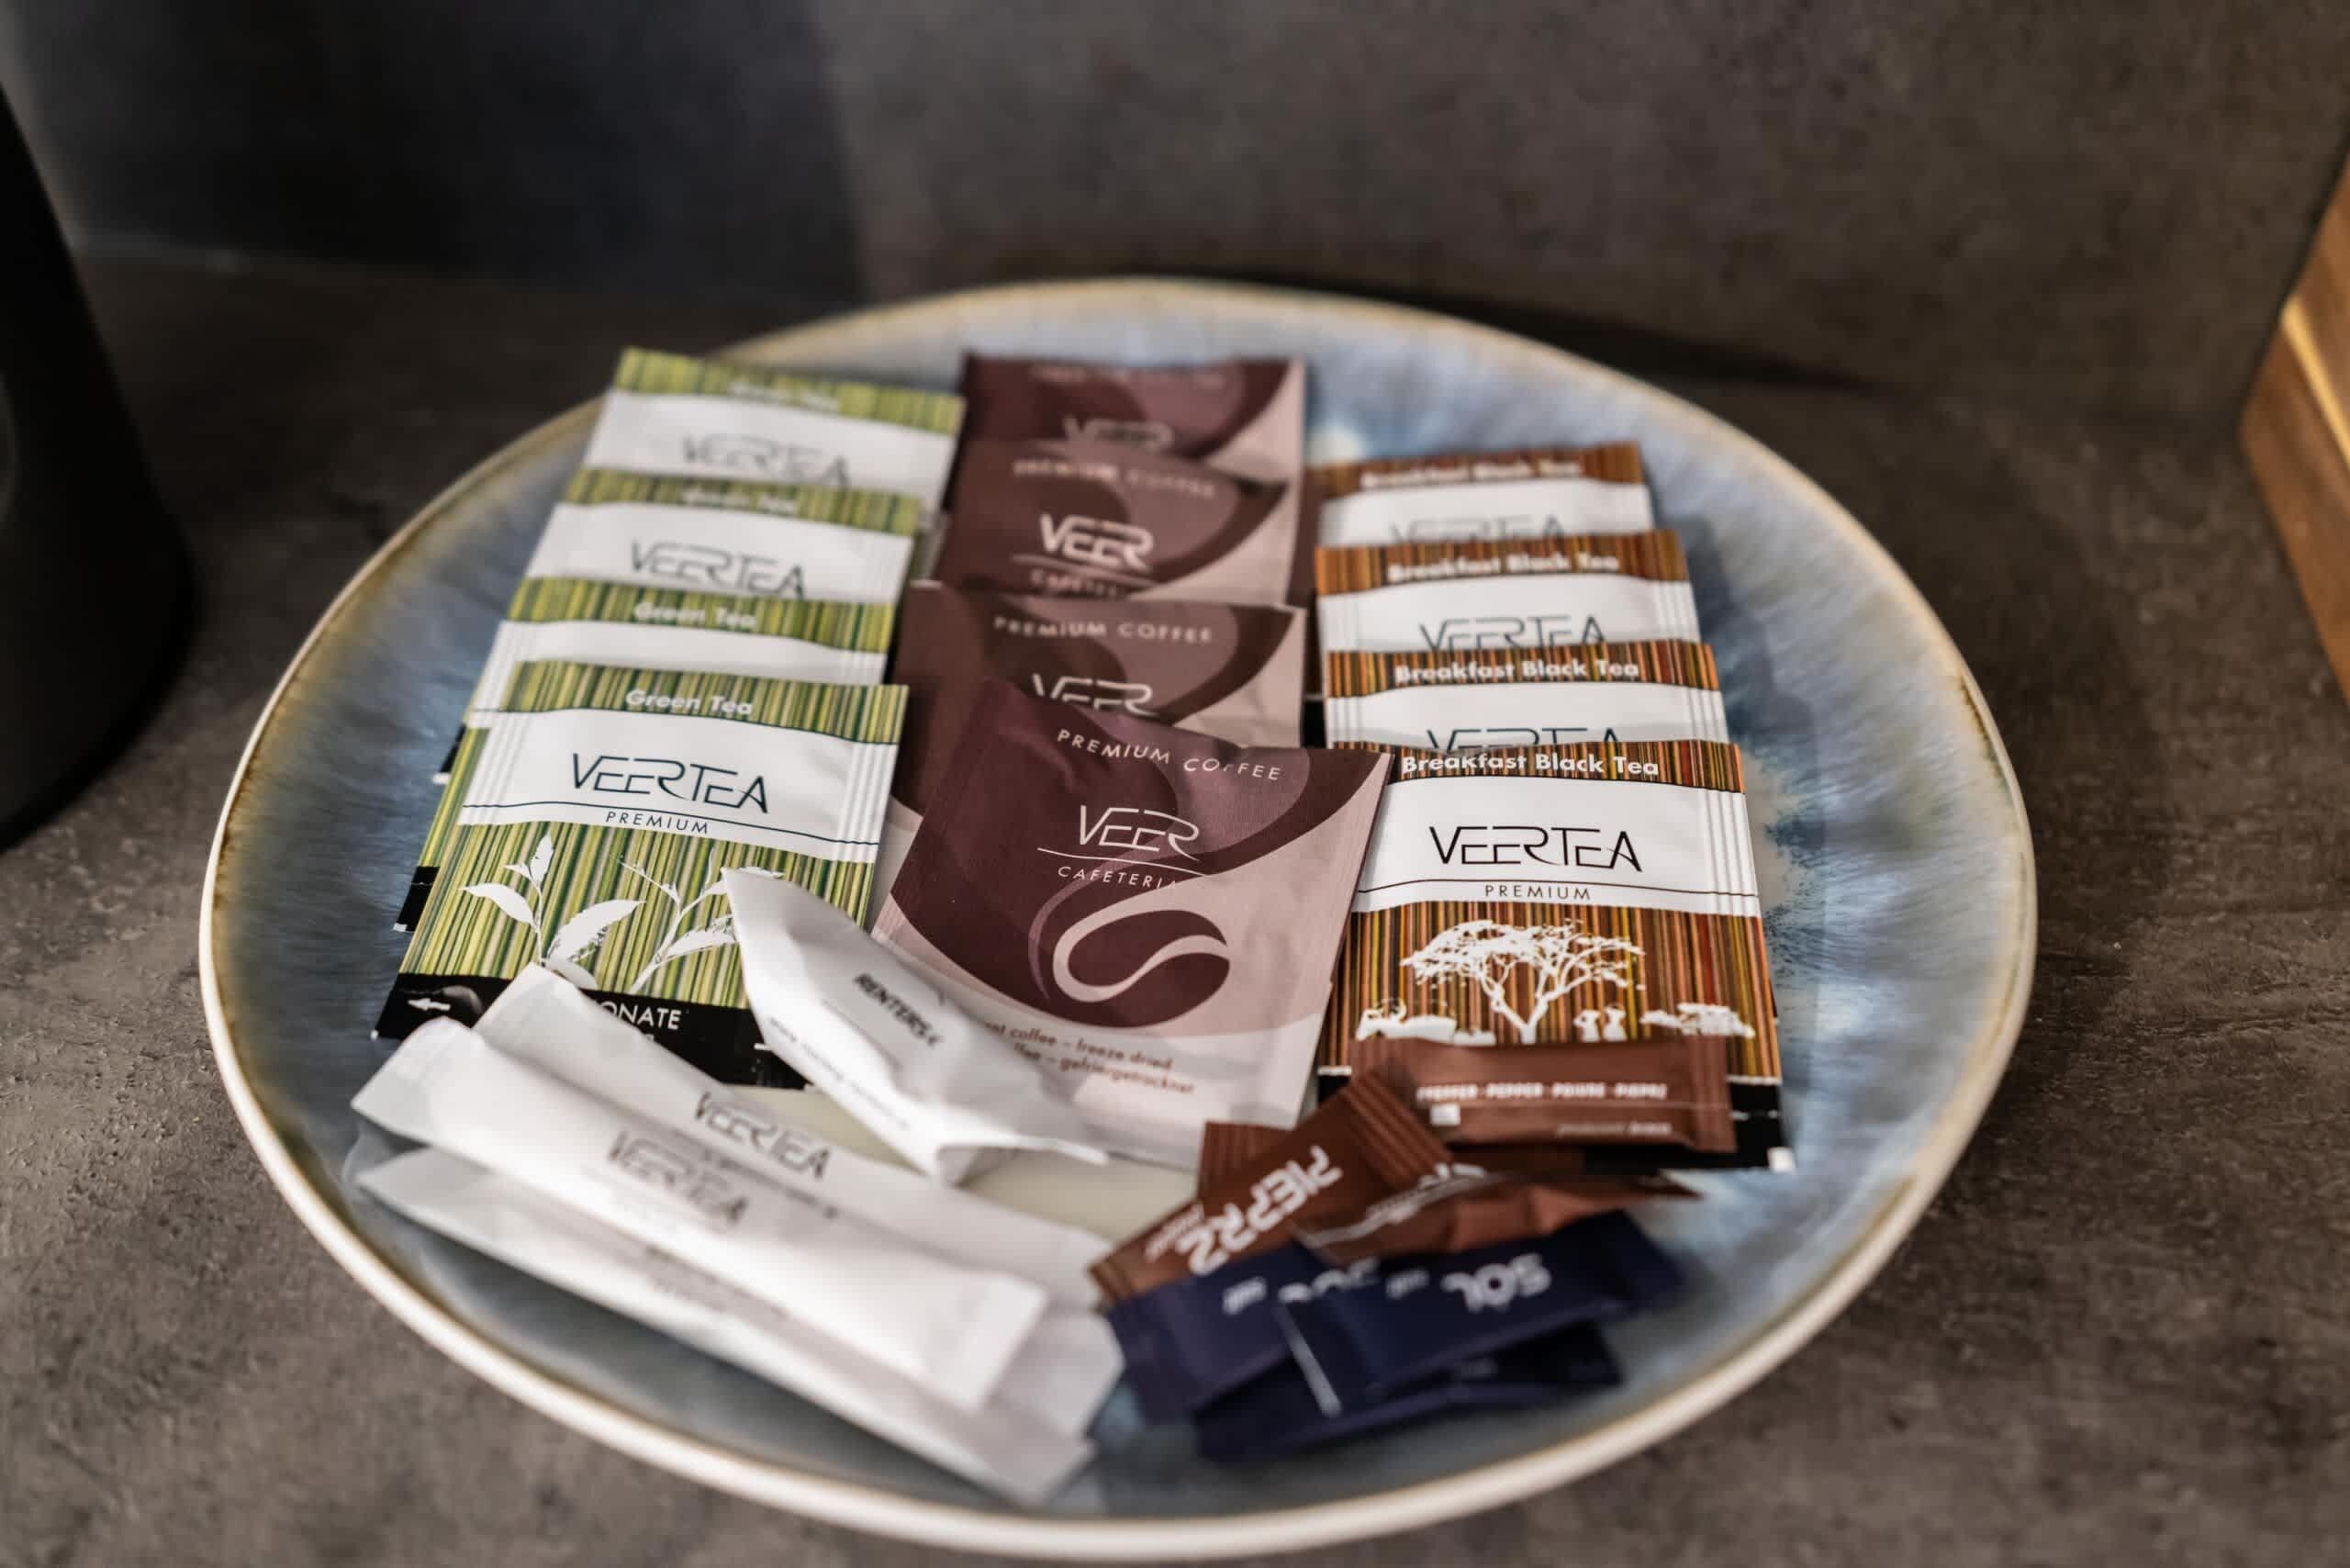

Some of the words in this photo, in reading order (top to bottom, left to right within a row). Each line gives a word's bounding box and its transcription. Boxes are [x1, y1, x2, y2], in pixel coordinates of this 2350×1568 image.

[1040, 512, 1153, 573] VEER
[631, 539, 805, 600] VEERTEA
[635, 601, 706, 624] Green
[716, 607, 756, 628] Tea
[994, 616, 1106, 637] PREMIUM
[1118, 622, 1211, 643] COFFEE
[1394, 662, 1515, 683] Breakfast
[1521, 658, 1587, 678] Black
[1596, 659, 1639, 678] Tea
[625, 689, 700, 710] Green
[711, 696, 753, 715] Tea
[1058, 729, 1170, 765] PREMIUM
[1402, 755, 1528, 775] Breakfast
[1535, 752, 1605, 773] Black
[1613, 756, 1659, 776] Tea
[572, 753, 768, 814] VEERTEA
[606, 811, 709, 834] PREMIUM
[1079, 804, 1202, 862] VEER
[1429, 826, 1643, 872] VEERTEA
[1058, 866, 1178, 890] CAFETERIA
[1484, 884, 1591, 901] PREMIUM
[1011, 1027, 1057, 1047] coffee
[1076, 1038, 1125, 1060] freeze
[1175, 1145, 1343, 1275] PIEPRZ
